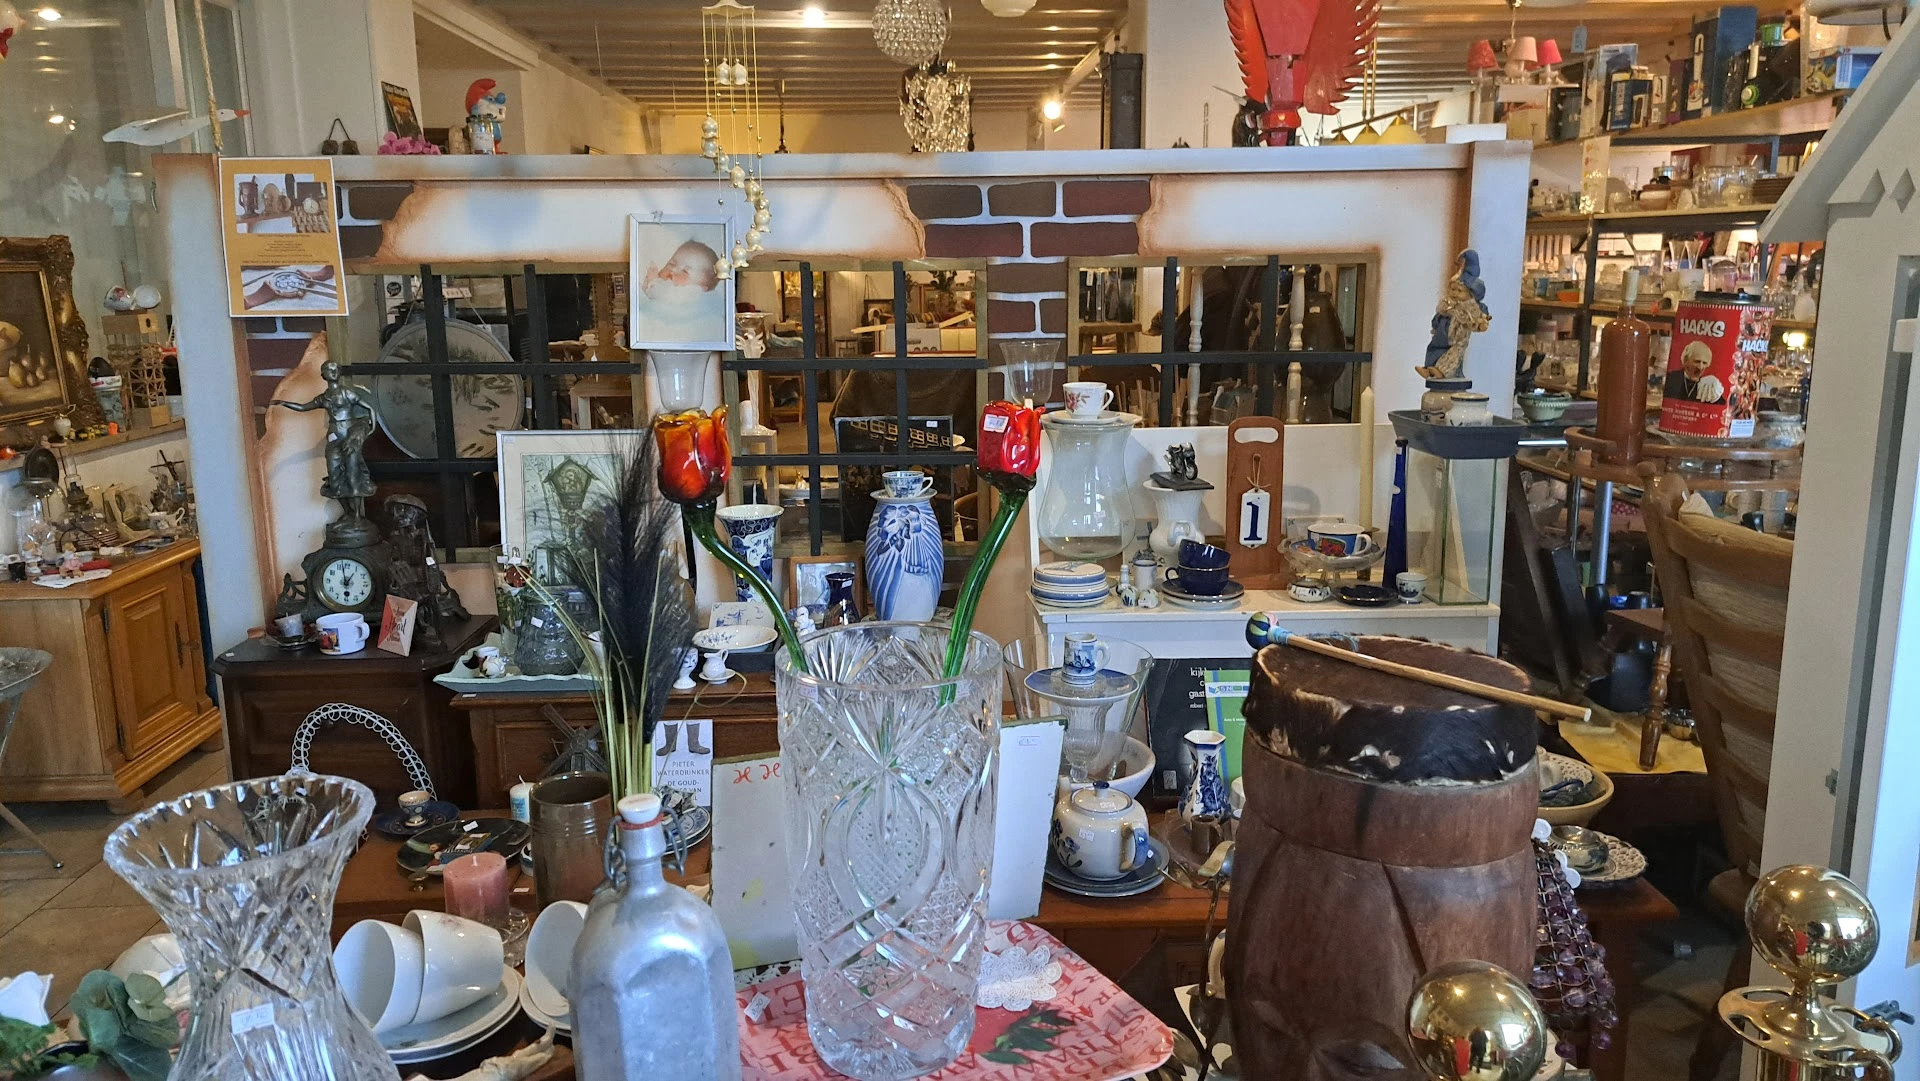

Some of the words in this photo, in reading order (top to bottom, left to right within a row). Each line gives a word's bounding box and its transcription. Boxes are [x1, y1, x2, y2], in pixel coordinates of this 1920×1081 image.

[1680, 319, 1725, 338] HACKS
[1244, 502, 1262, 540] 1
[1188, 690, 1205, 699] gast
